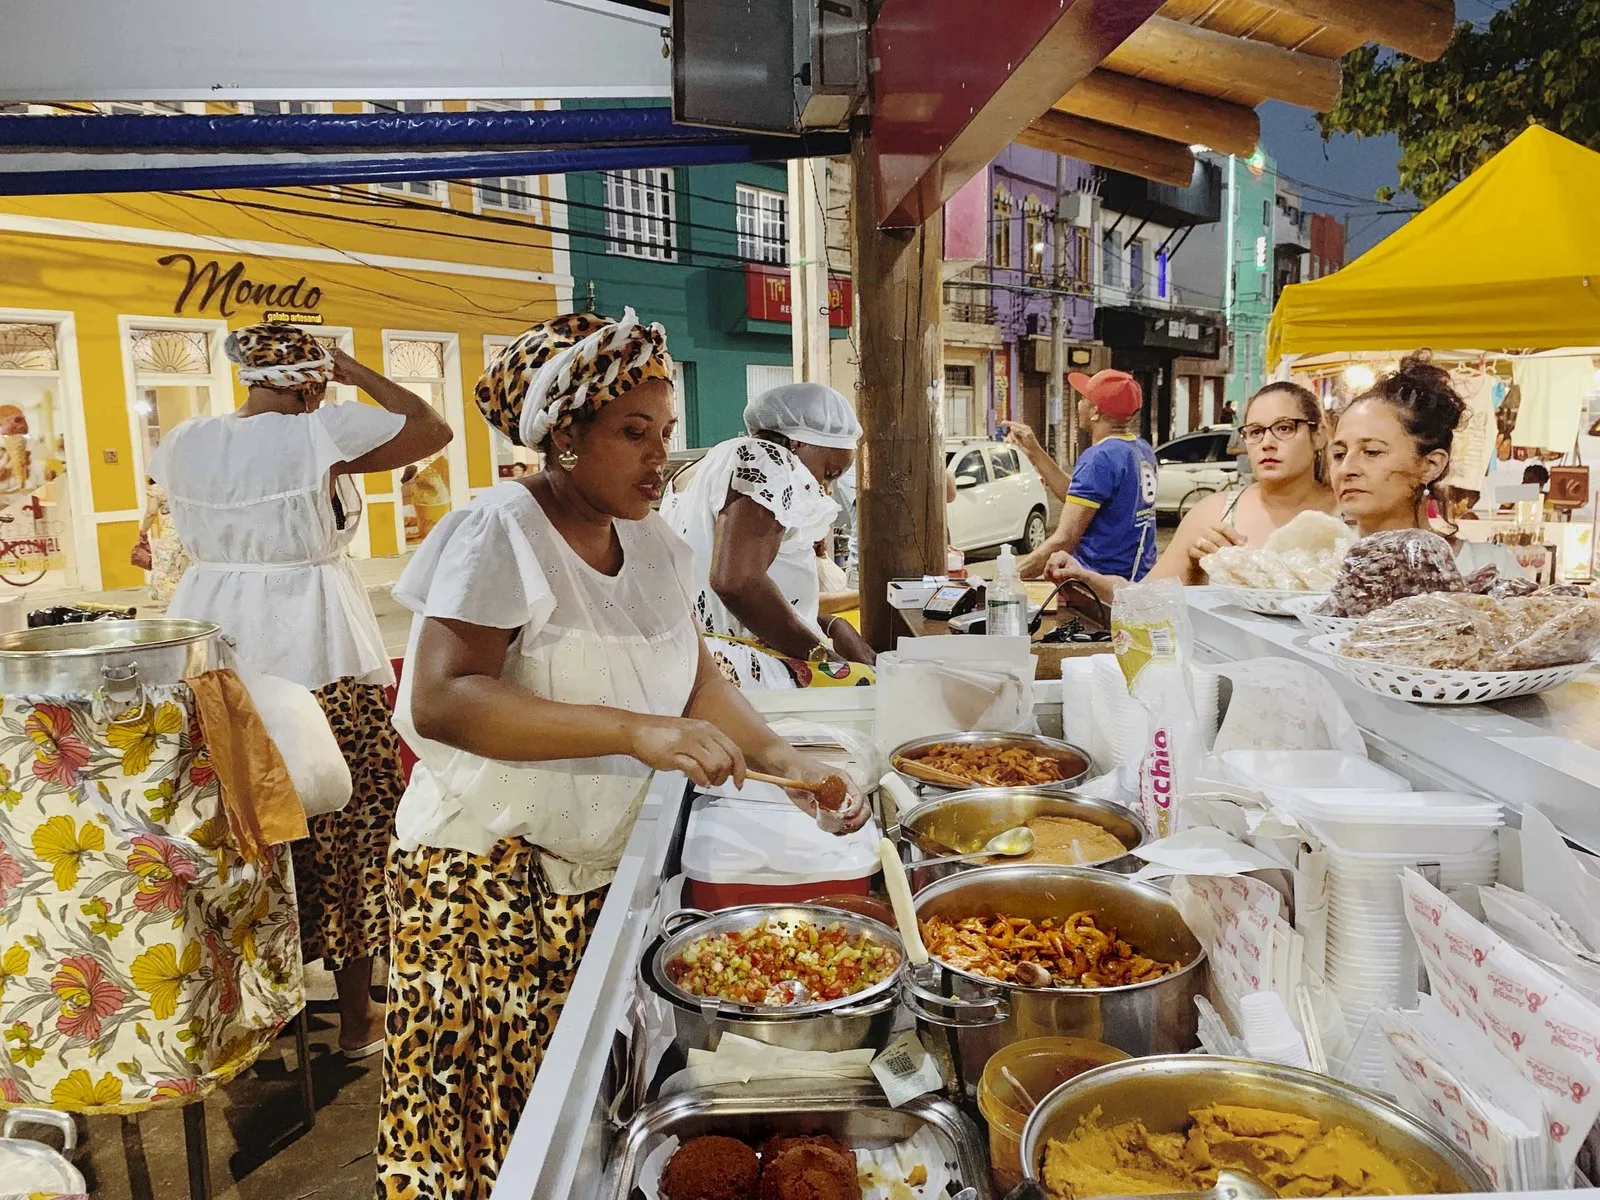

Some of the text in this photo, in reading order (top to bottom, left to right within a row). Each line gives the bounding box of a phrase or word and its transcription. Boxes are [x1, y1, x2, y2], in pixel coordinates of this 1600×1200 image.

[156, 253, 324, 318] Mondo
[267, 312, 322, 324] gelato artesanal
